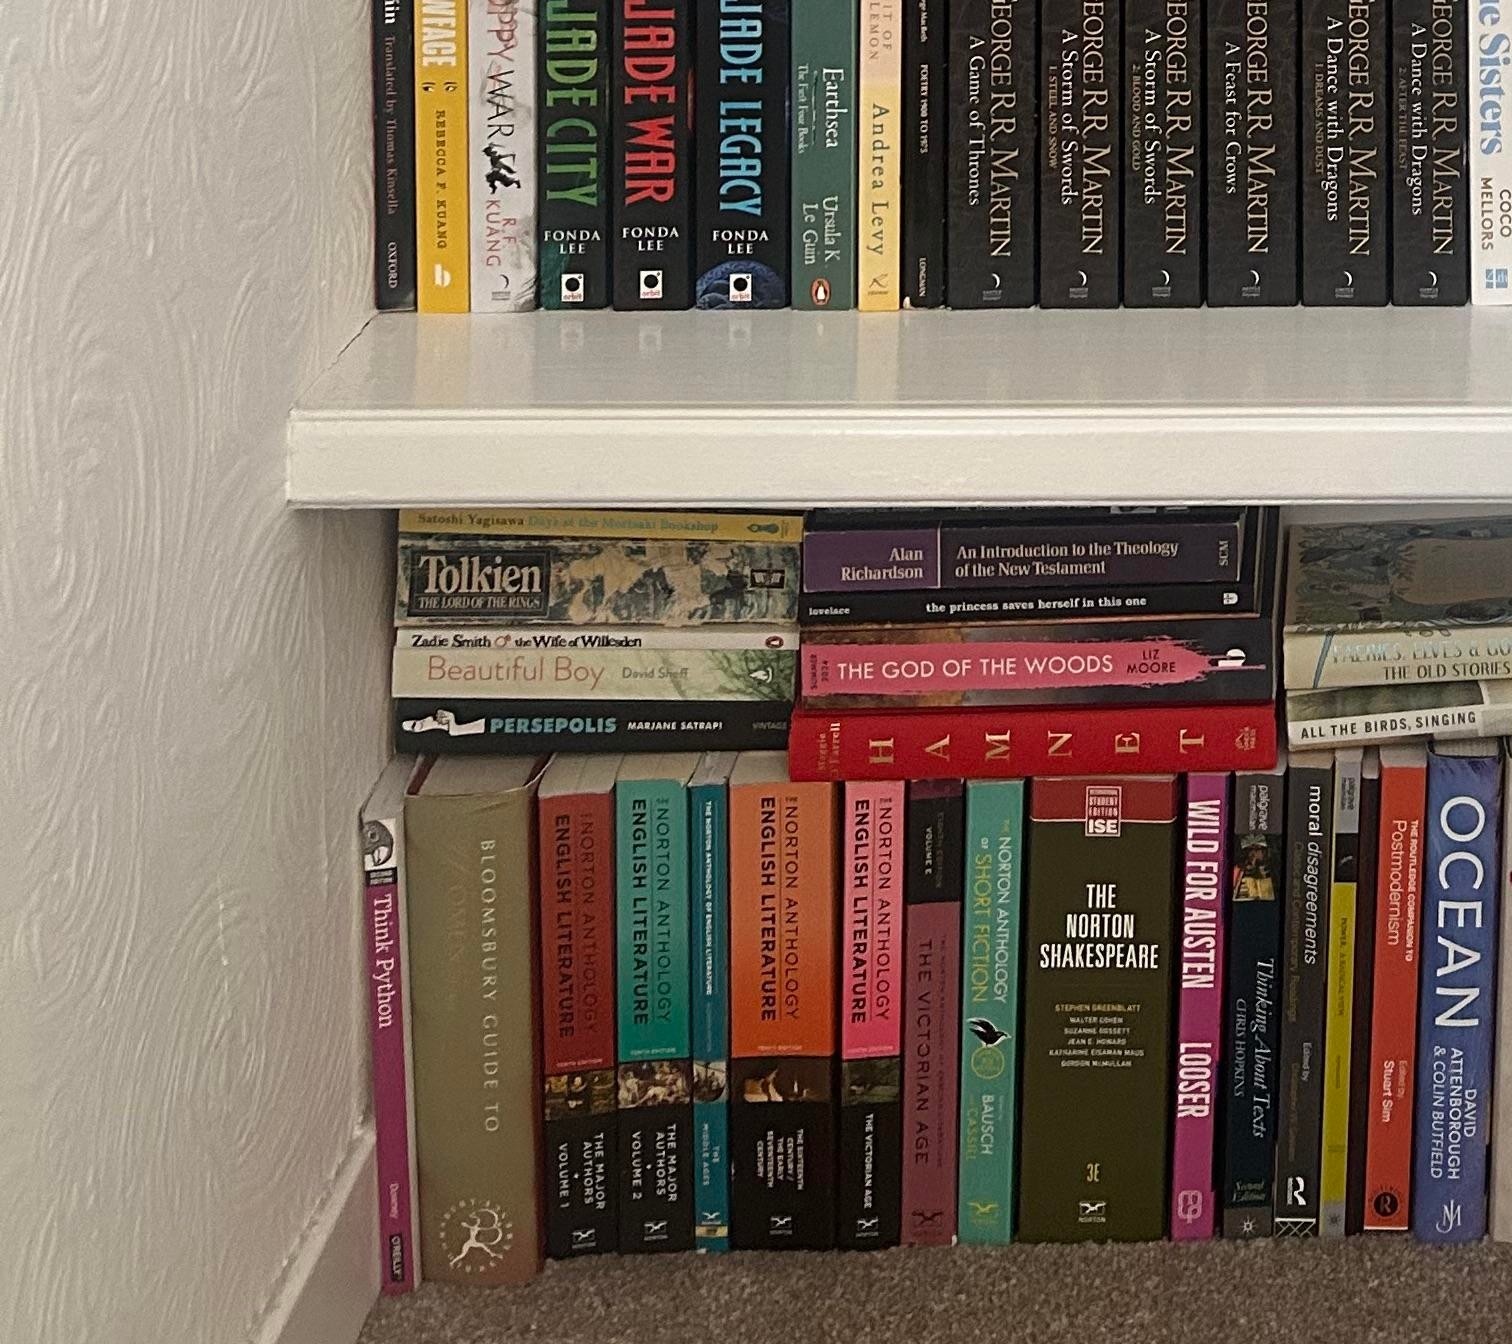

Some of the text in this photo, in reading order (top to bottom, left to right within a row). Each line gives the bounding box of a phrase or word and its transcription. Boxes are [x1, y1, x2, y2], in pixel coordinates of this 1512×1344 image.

[545, 0, 597, 208] JADE CITY
[823, 68, 845, 148] Earthsea
[1479, 33, 1510, 155] Sisters
[719, 100, 762, 216] LEGACY
[990, 148, 1018, 256] MARTIN
[544, 230, 601, 243] FONDA
[559, 244, 585, 254] LEE
[419, 554, 543, 596] Tolkien
[837, 653, 1113, 678] THE GOD OF THE WOODS
[489, 716, 616, 734] PERSEPOLIS
[1301, 712, 1476, 739] ALL THE BIRDS, SINGING
[631, 799, 649, 1024] ENGLISH LITERATURE
[1066, 914, 1134, 938] NORTON
[1086, 884, 1116, 908] THE
[1387, 819, 1406, 945] Postmodernism
[1435, 796, 1485, 1027] OCEAN
[375, 895, 396, 1028] Think Python
[481, 840, 500, 1132] BLOOMSBURY GUIDE TO
[1039, 944, 1159, 969] SHAKESPEARE
[1177, 800, 1220, 1118] WILD FOR AUSTEN LOOSER
